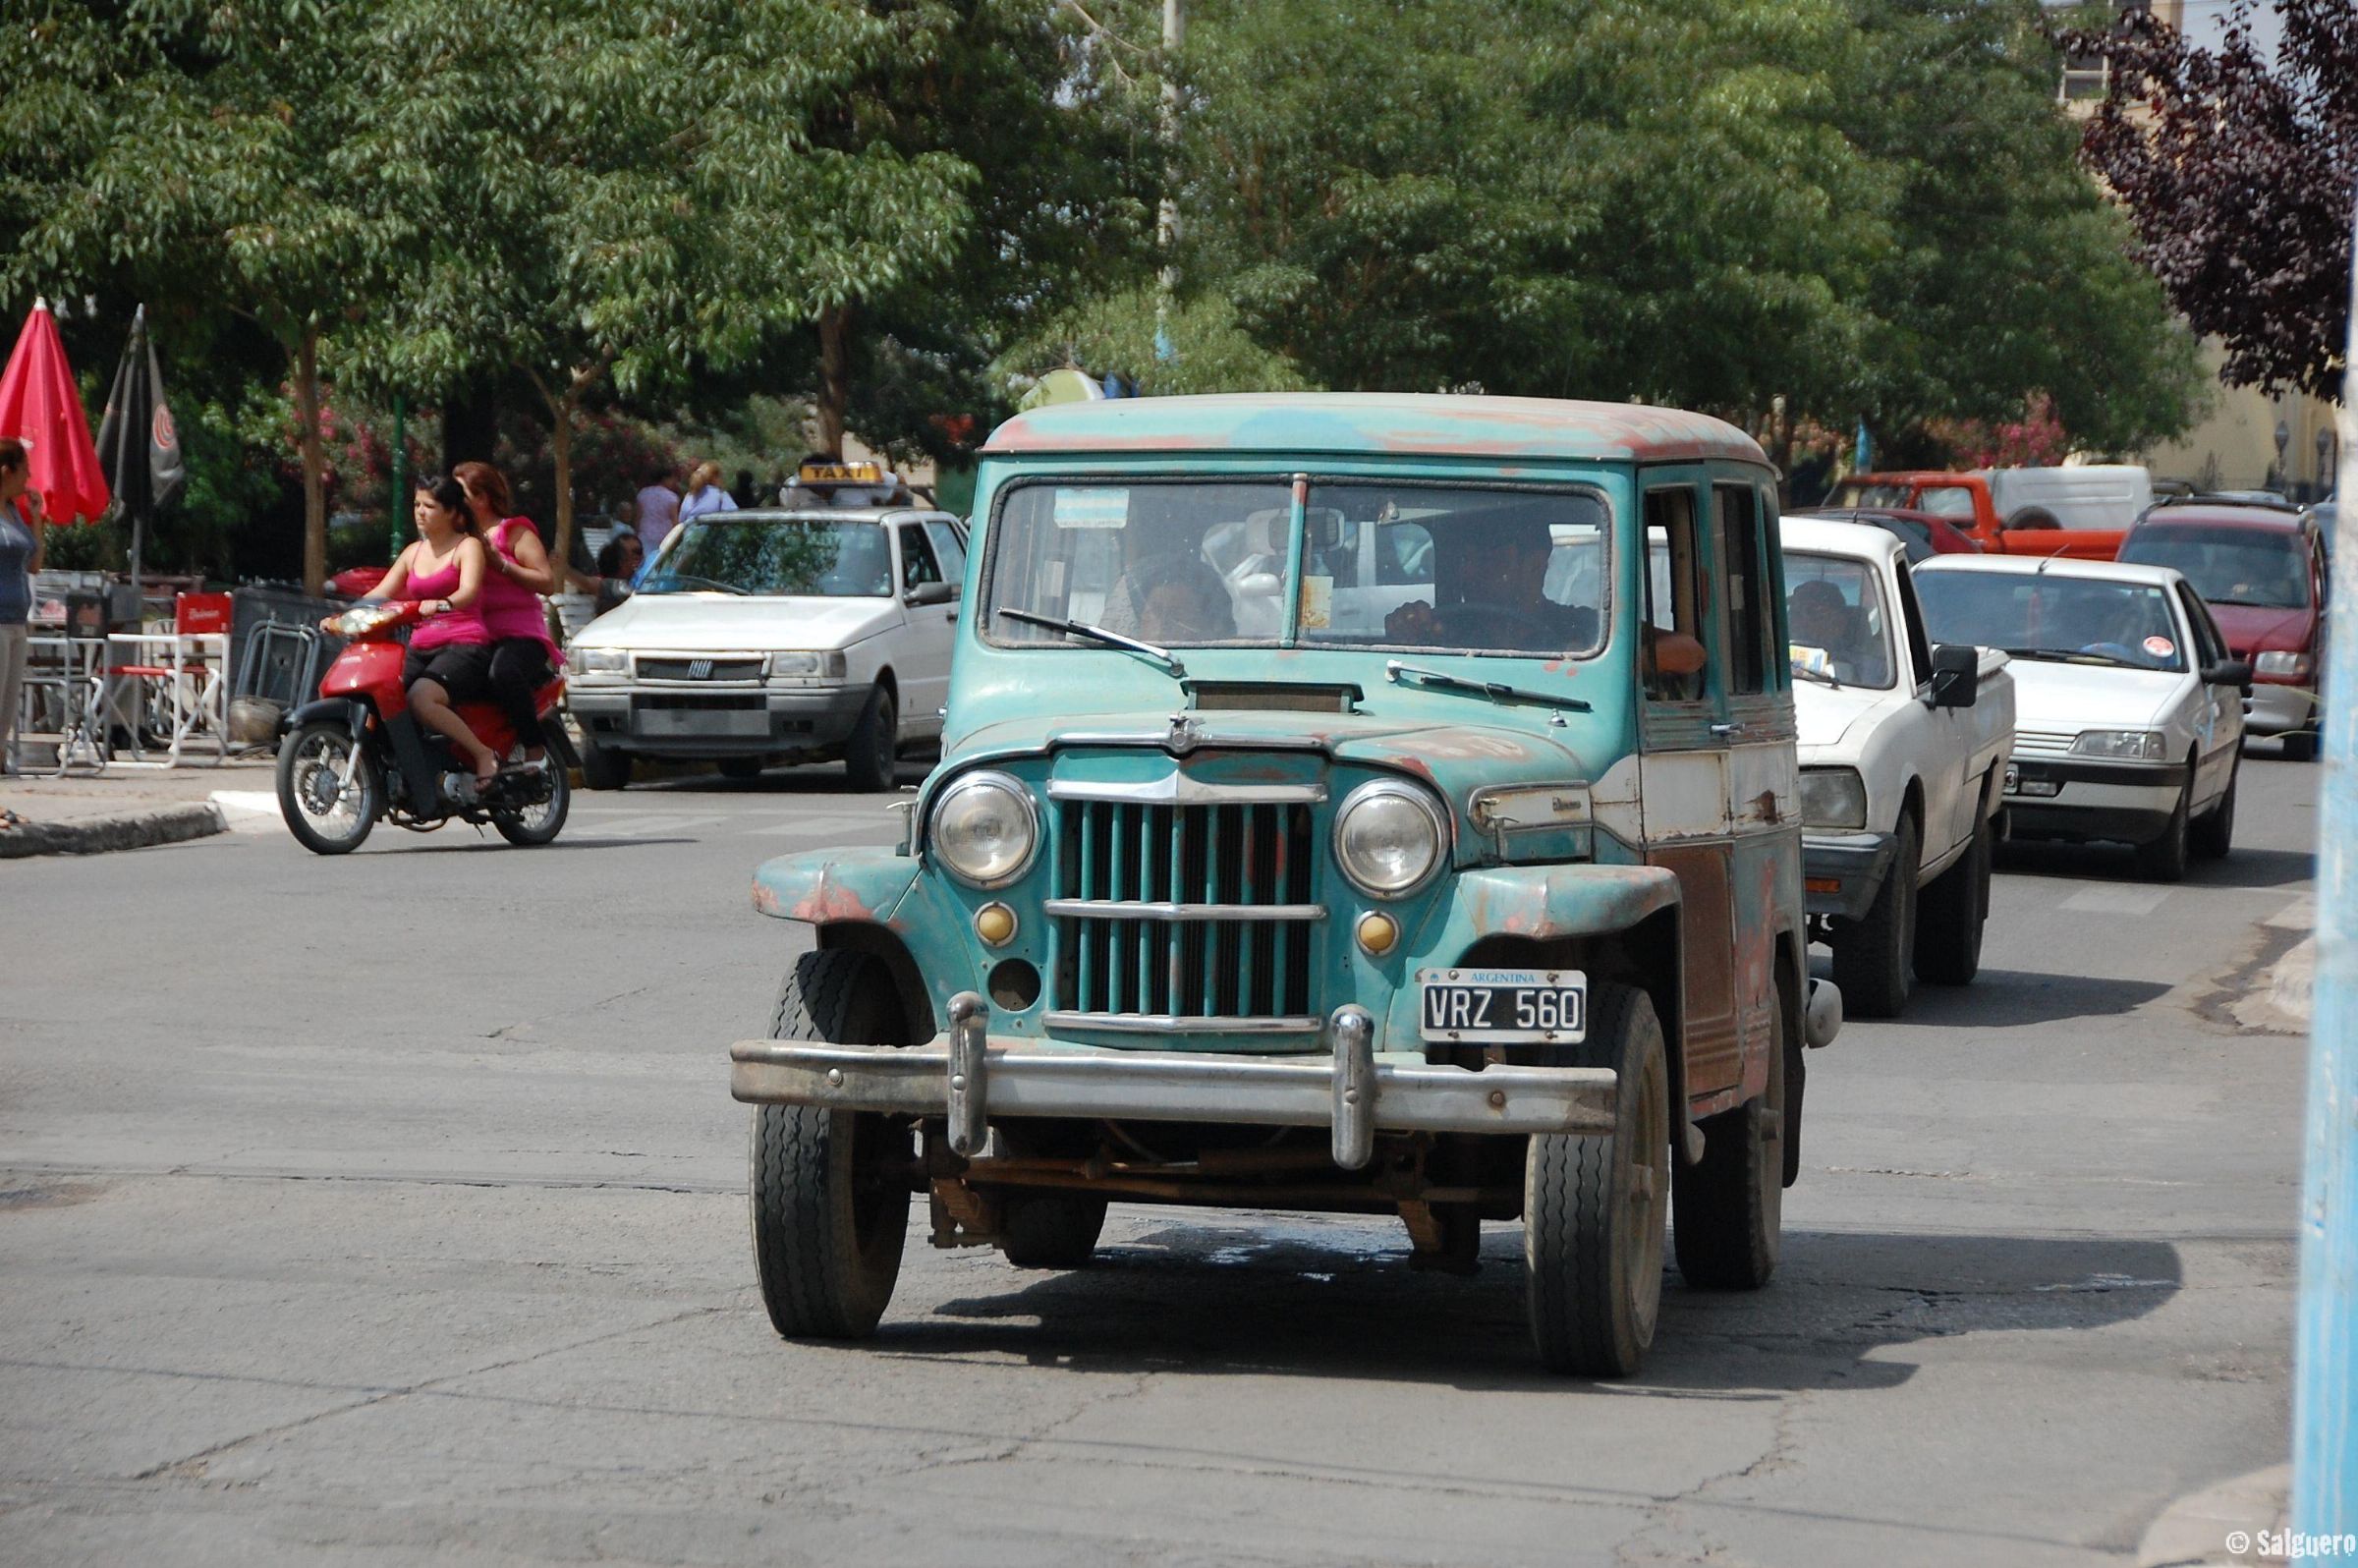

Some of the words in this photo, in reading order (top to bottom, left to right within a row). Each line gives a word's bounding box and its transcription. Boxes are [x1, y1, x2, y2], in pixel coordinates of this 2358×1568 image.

[810, 467, 863, 478] TAXI
[1470, 973, 1536, 982] ARGENTINA
[1430, 988, 1492, 1028] VRZ
[1516, 989, 1580, 1029] 560
